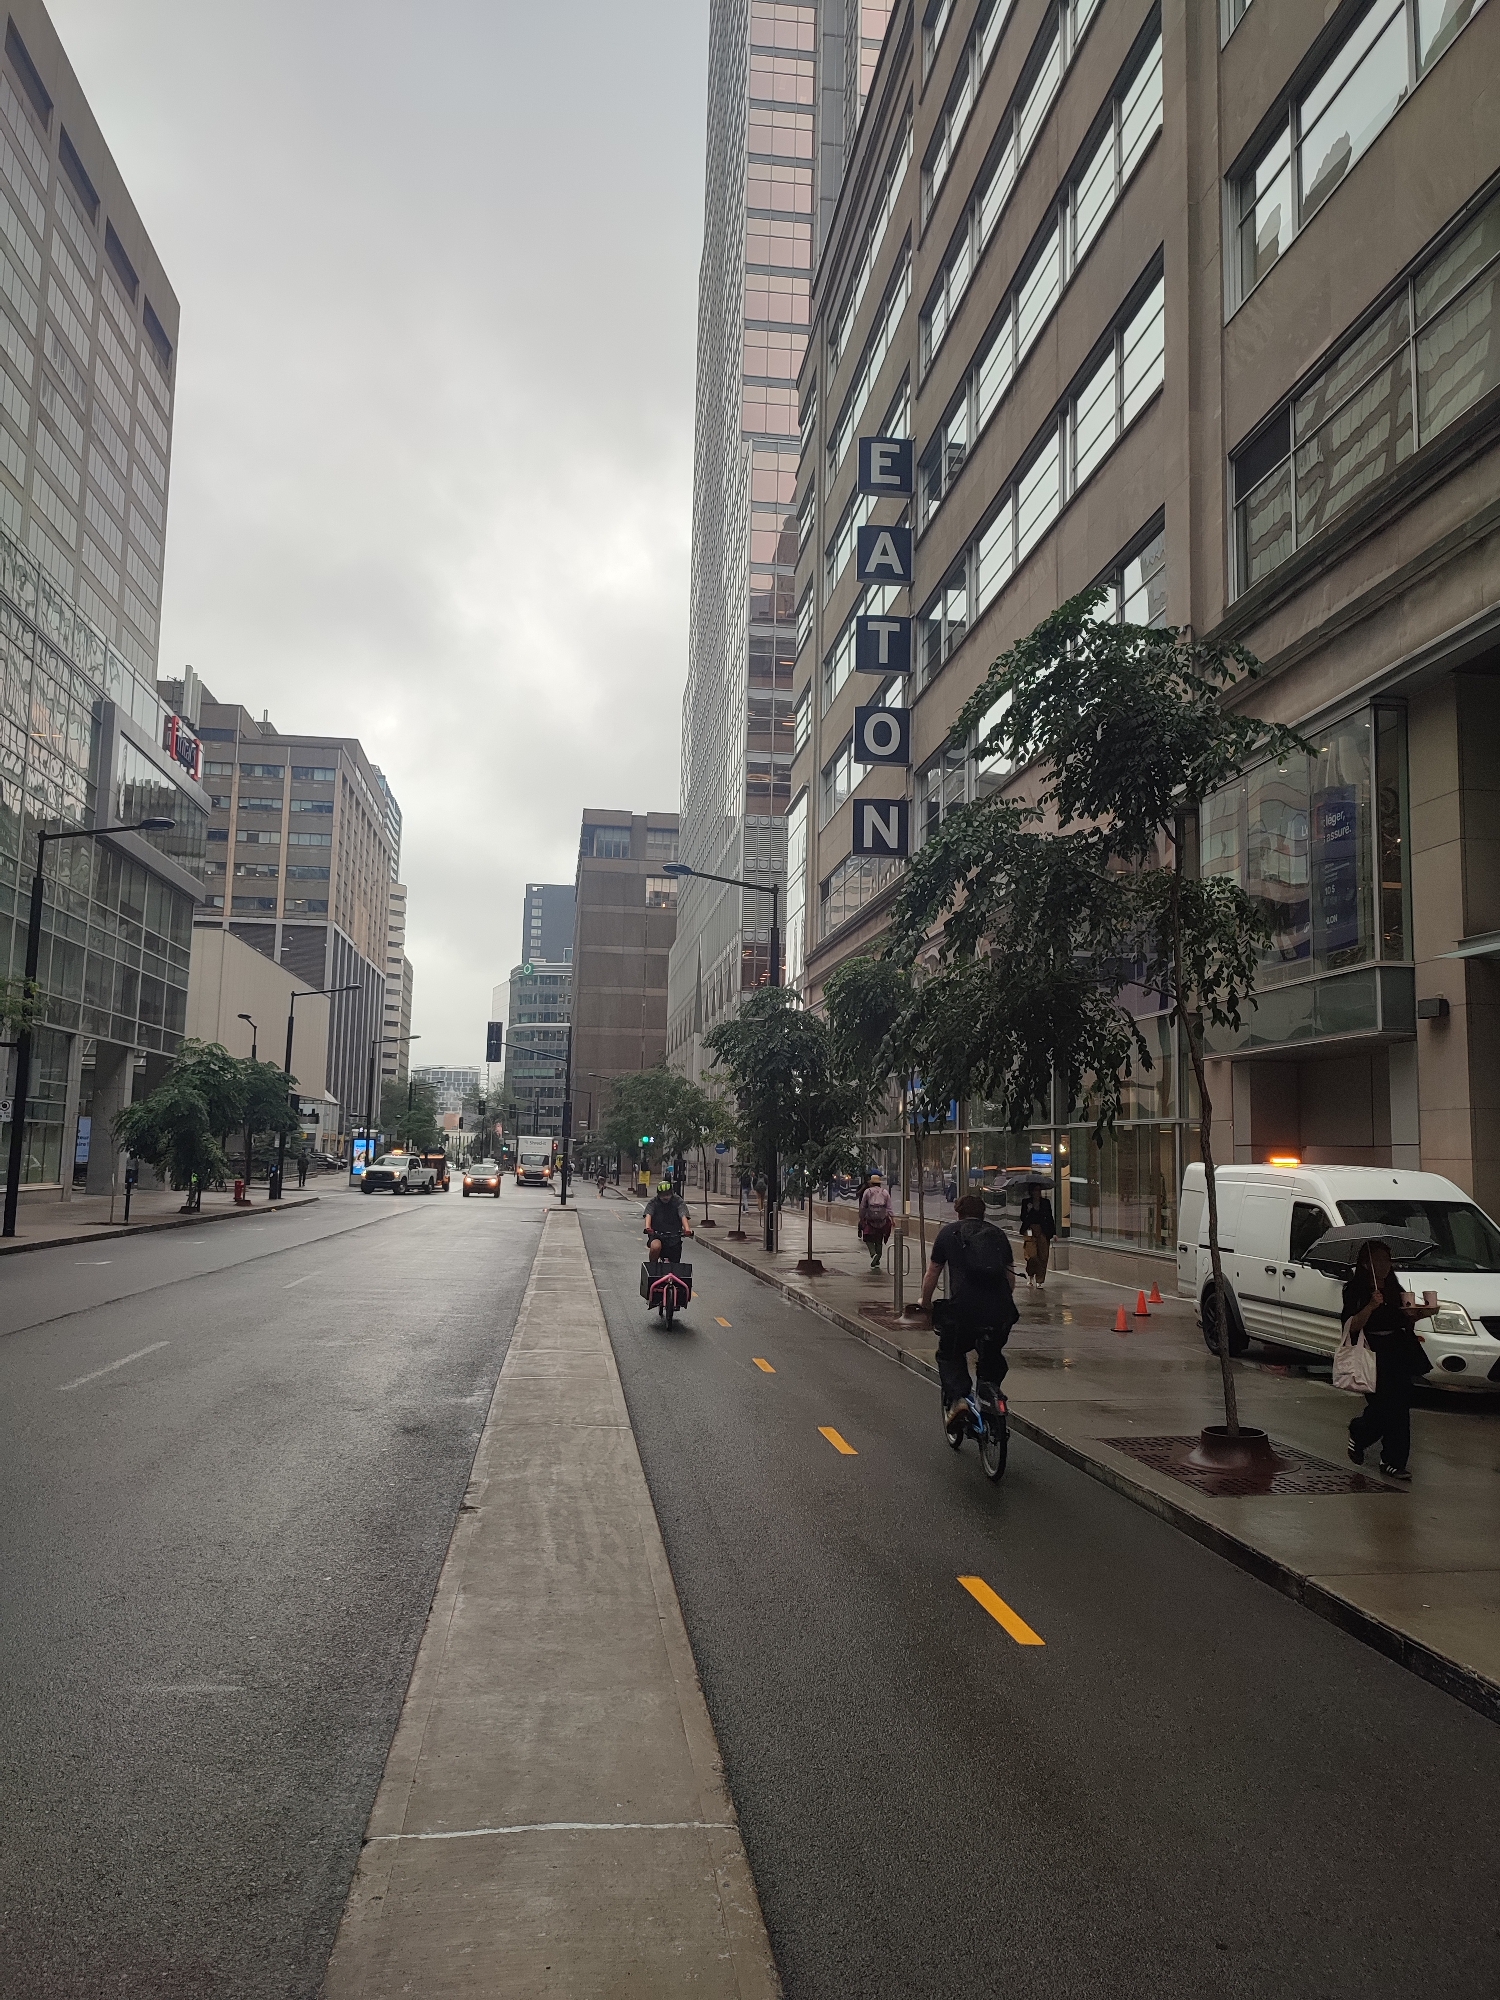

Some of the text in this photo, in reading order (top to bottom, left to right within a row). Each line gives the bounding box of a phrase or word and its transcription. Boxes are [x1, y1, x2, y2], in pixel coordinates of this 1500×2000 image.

[863, 442, 904, 850] EATON
[1325, 811, 1346, 827] léger,
[1326, 822, 1352, 842] assuré.
